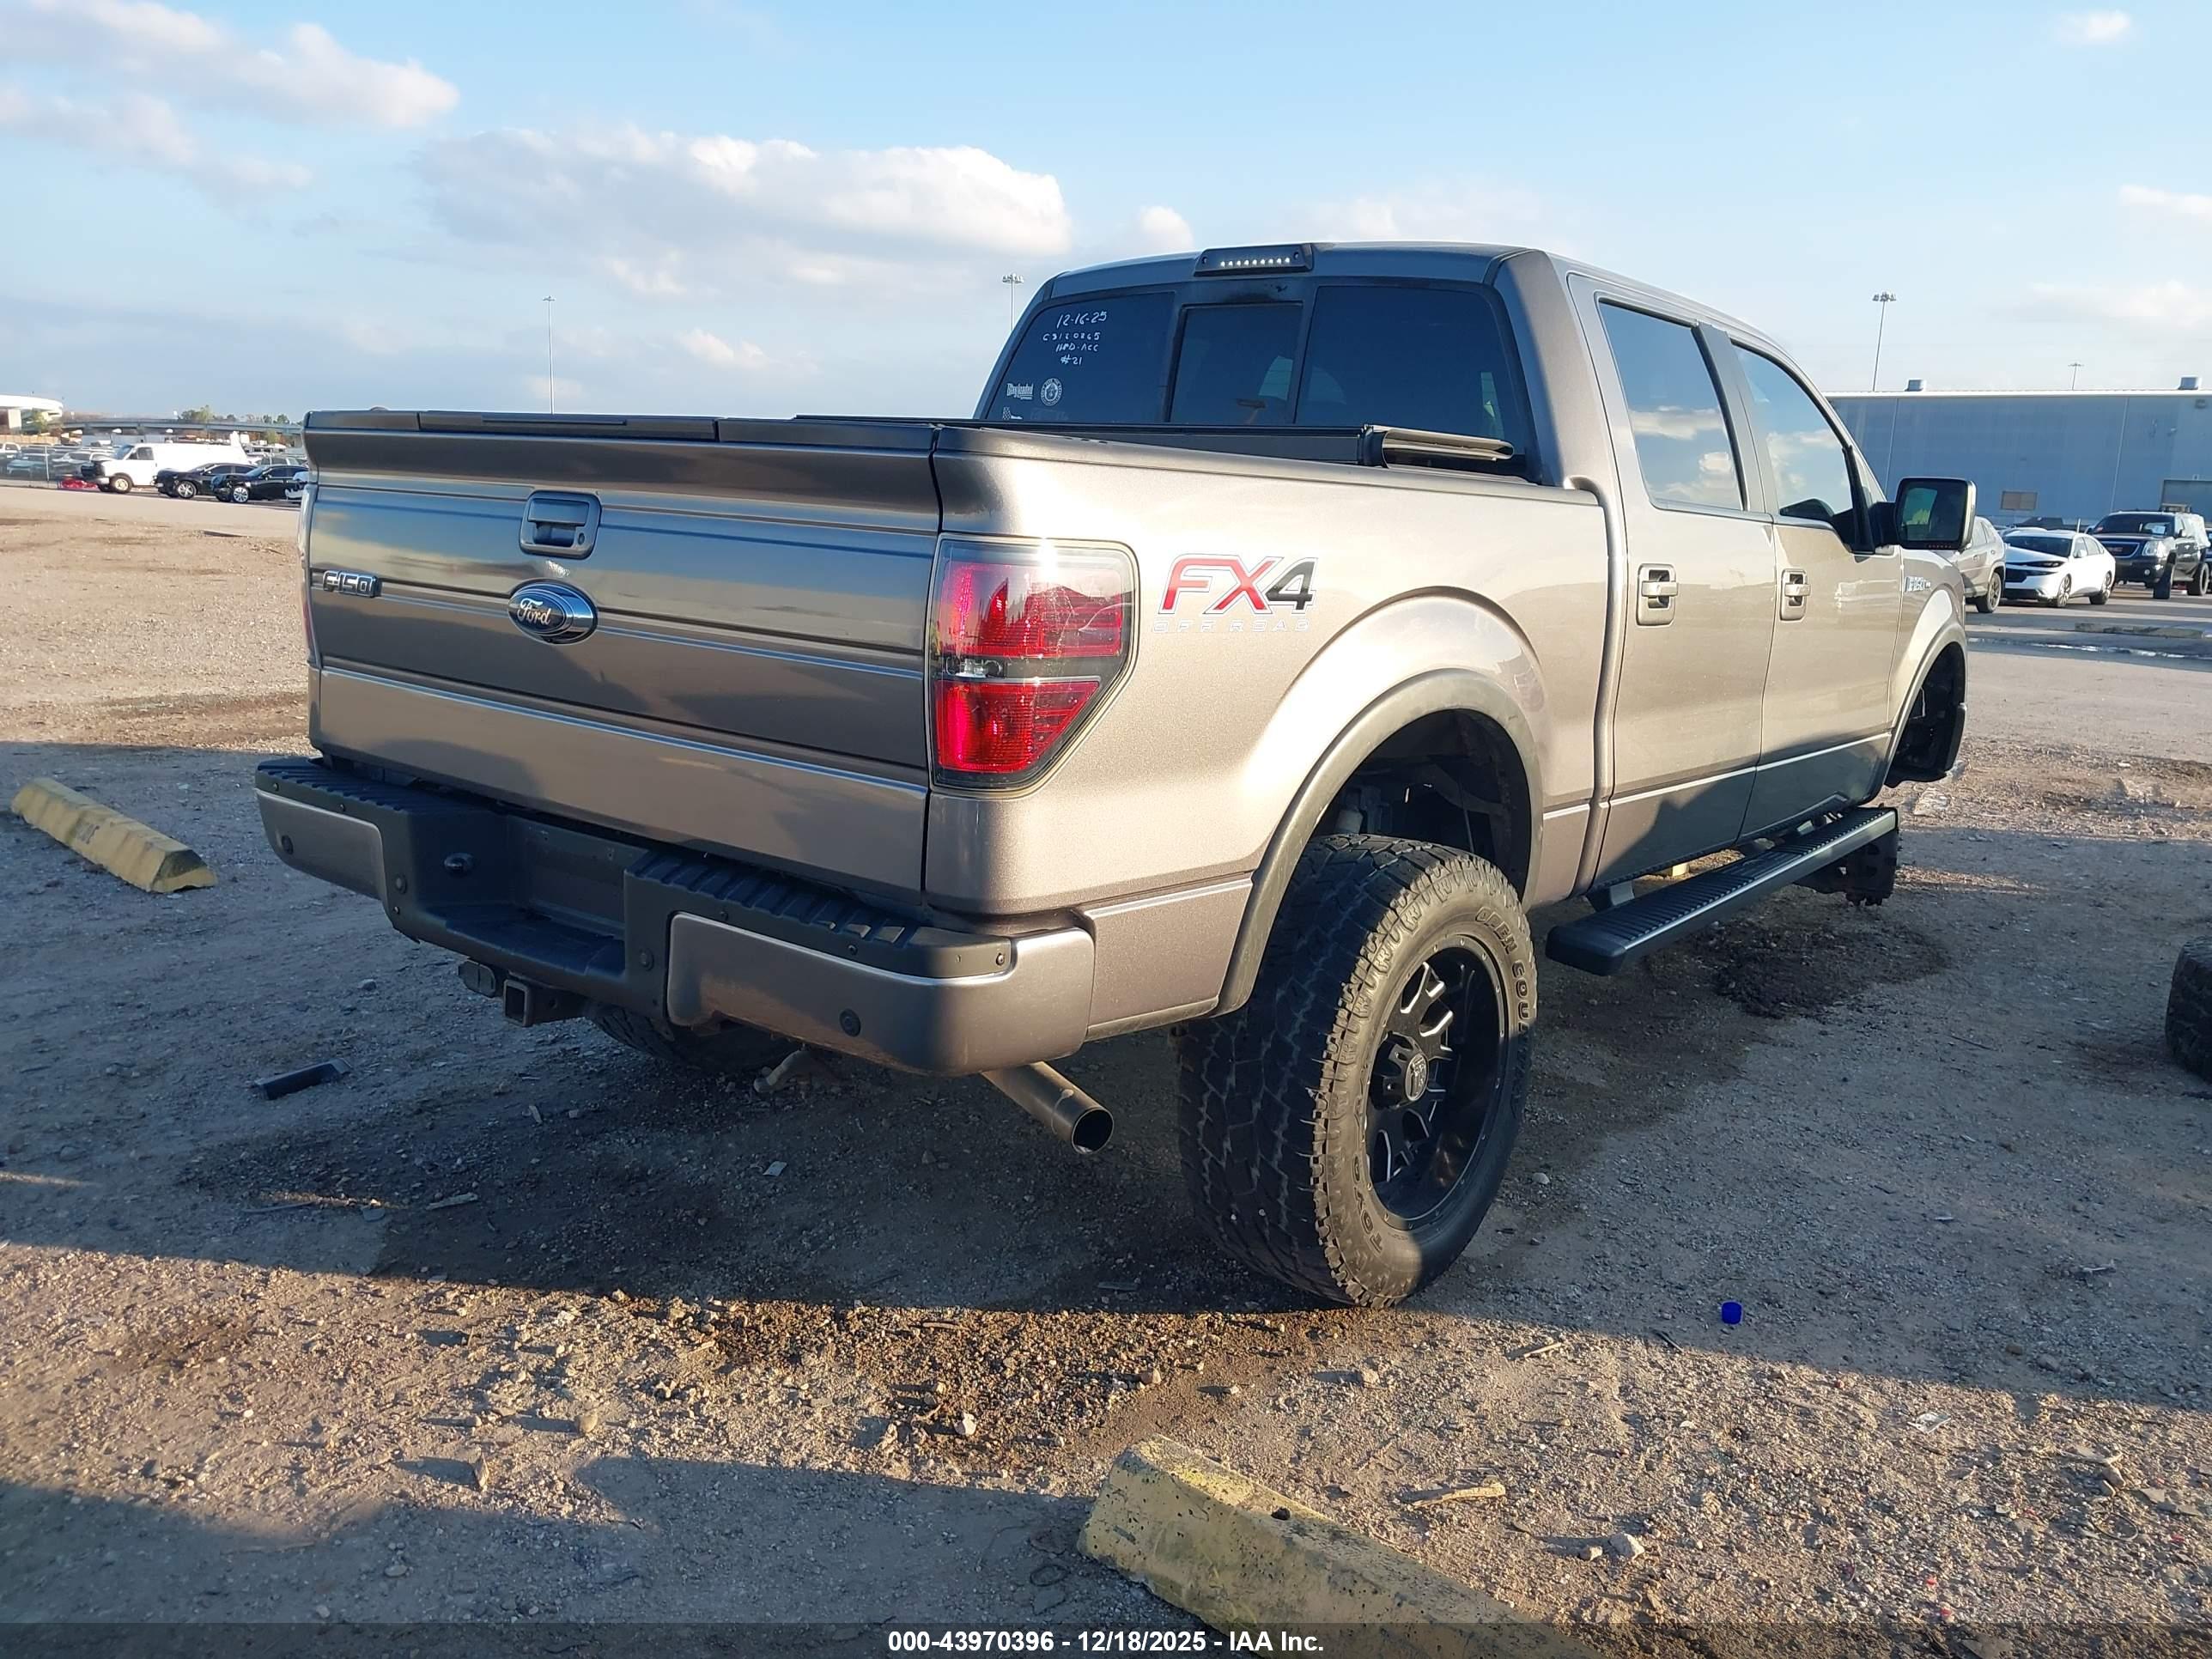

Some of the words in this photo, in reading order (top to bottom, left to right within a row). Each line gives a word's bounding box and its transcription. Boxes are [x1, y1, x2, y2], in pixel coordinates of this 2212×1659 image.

[1056, 311, 1108, 329] 12-16-25
[1060, 354, 1083, 366] #21
[1158, 553, 1319, 615] FX4
[517, 598, 551, 625] Ford
[1475, 906, 1518, 956] OPEN
[1352, 1152, 1383, 1255] TOYO
